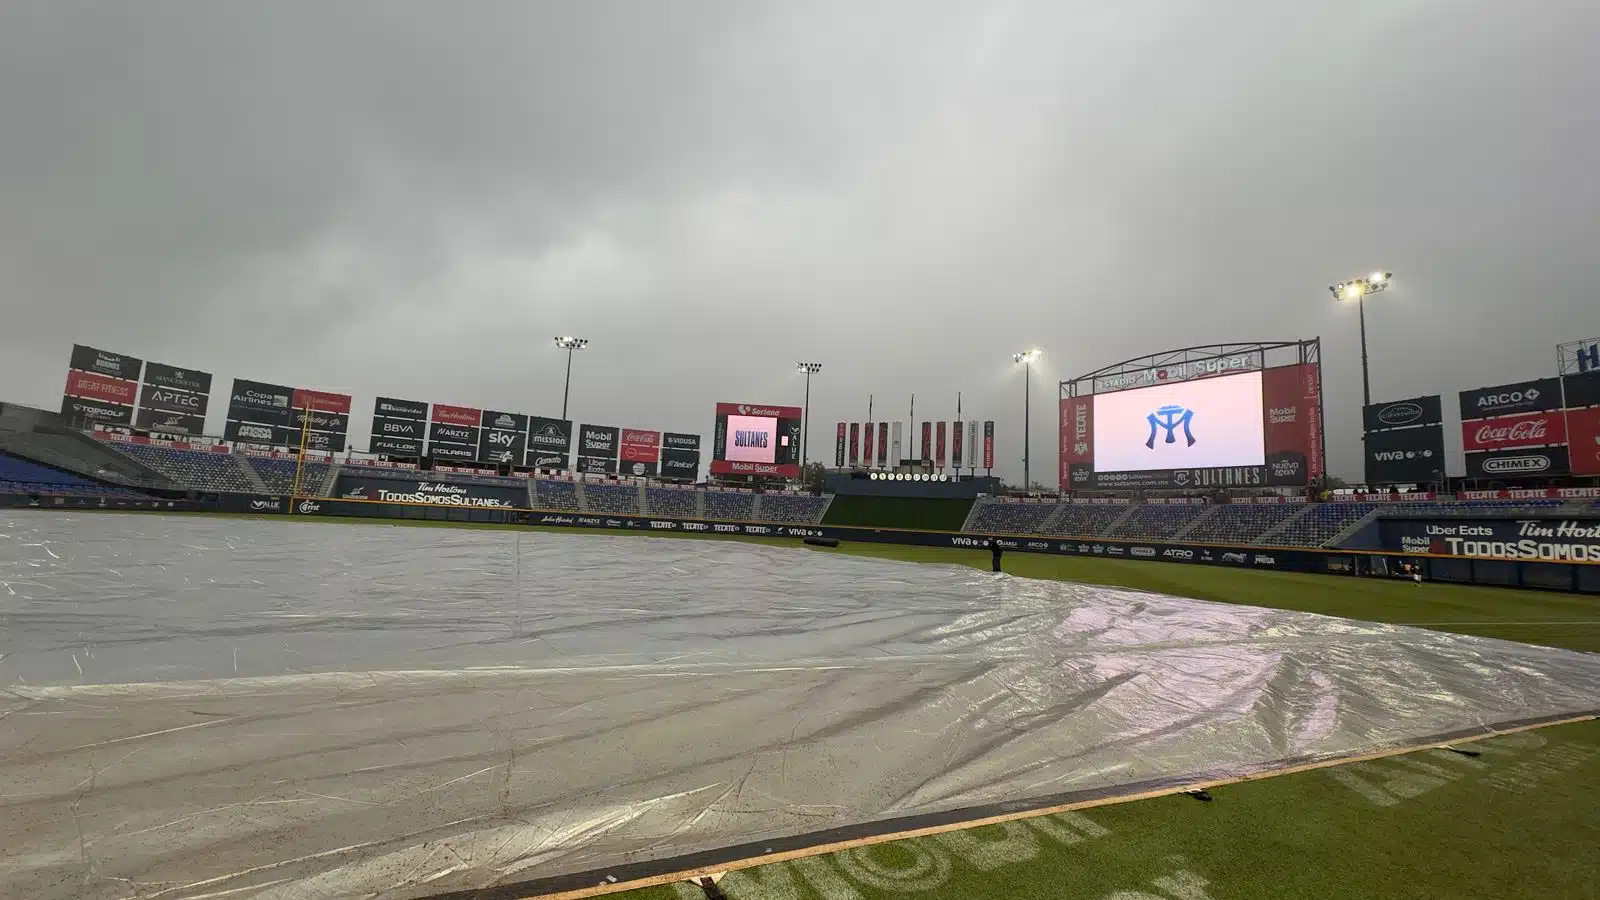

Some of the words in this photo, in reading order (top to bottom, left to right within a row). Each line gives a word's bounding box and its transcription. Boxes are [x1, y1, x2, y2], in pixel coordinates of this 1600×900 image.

[1143, 364, 1187, 383] Mobil
[1195, 355, 1248, 374] Super
[246, 389, 273, 400] Copa
[1477, 391, 1522, 407] ARCO
[233, 395, 272, 406] Airlines
[82, 405, 125, 417] TOPGOLF
[438, 410, 451, 418] Tim
[451, 411, 475, 421] Hortons
[752, 407, 780, 416] Soriana
[1269, 406, 1296, 416] Mobil
[1076, 403, 1086, 440] TECATE
[1269, 414, 1296, 424] Super
[384, 423, 414, 433] BBVA
[110, 433, 132, 442] TECATE
[489, 431, 515, 447] sky
[586, 431, 612, 441] Mobil
[735, 430, 768, 448] SULTANES
[150, 438, 172, 448] TECATE
[190, 443, 212, 452] TECATE
[586, 439, 611, 449] Super
[249, 450, 272, 458] TECATE
[432, 448, 472, 457] POLARIS
[374, 460, 393, 468] TECATE
[535, 455, 562, 467] Clamato
[674, 459, 695, 468] telcel
[1488, 458, 1541, 469] CHIMEX
[732, 462, 753, 471] Mobil
[755, 464, 778, 473] Super
[1194, 468, 1260, 486] SULTANES
[418, 481, 433, 491] Tim
[434, 482, 467, 494] Hortons
[1097, 479, 1168, 487] www.sultanes.com.mx
[1334, 494, 1358, 502] TECATE
[1364, 492, 1391, 501] TECATE
[1398, 492, 1428, 501] TECATE
[1464, 490, 1498, 500] TECATE
[1508, 489, 1547, 499] TECATE
[650, 520, 672, 529] TECATE
[682, 522, 704, 531] TECATE
[713, 524, 735, 532] TECATE
[745, 525, 767, 533] TECATE
[1516, 520, 1553, 537] Tim
[1425, 525, 1457, 536] Uber
[1459, 525, 1493, 536] Eats
[1402, 536, 1431, 545] Mobil
[1162, 548, 1194, 557] ATRO
[1402, 544, 1430, 553] Super
